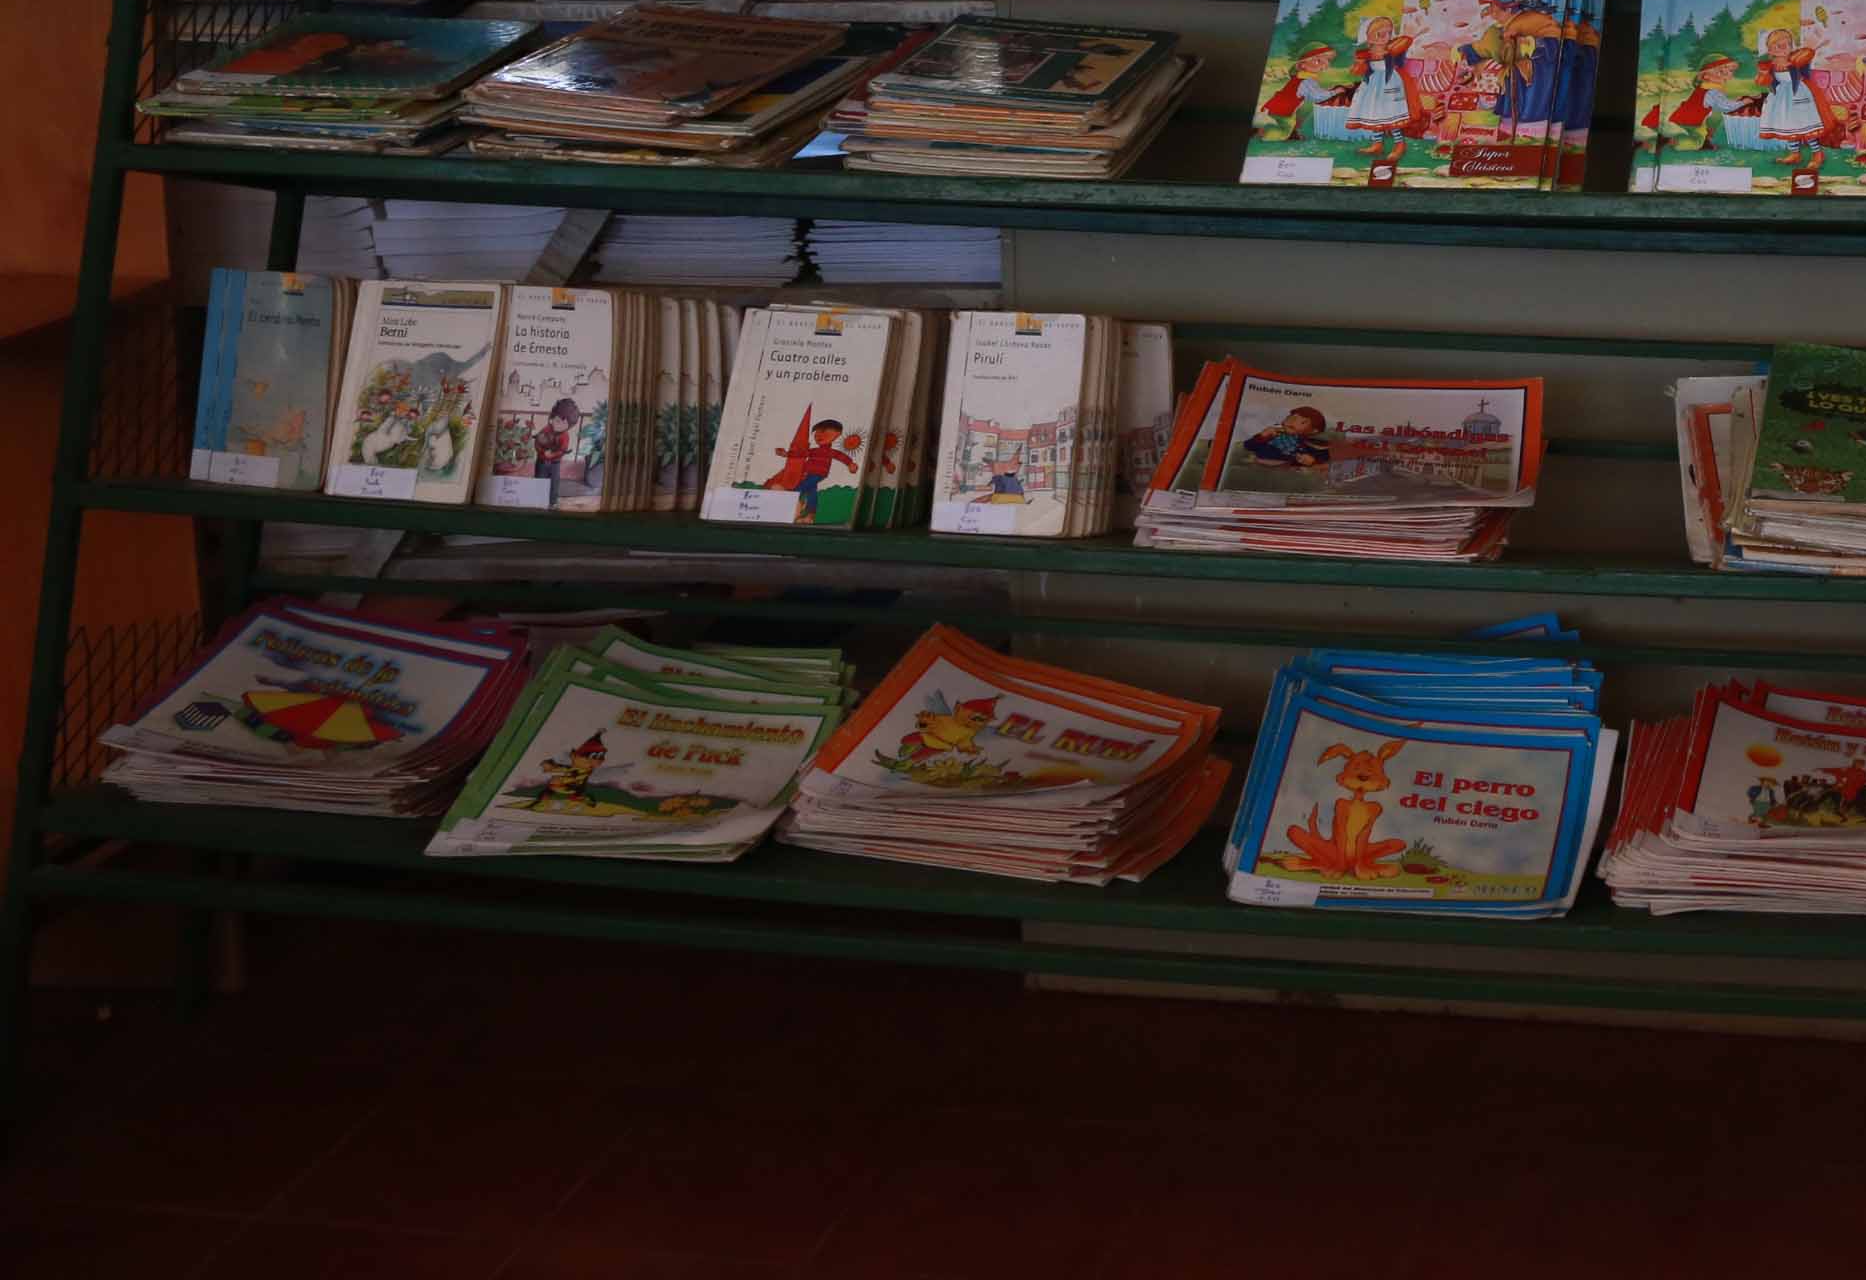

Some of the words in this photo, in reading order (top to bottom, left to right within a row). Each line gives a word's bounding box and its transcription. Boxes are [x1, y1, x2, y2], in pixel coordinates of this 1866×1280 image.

[379, 326, 409, 338] Berni
[515, 324, 528, 337] La
[530, 325, 571, 340] historia
[513, 341, 527, 354] de
[528, 342, 569, 356] Ernesto
[769, 349, 810, 365] Cuatro
[812, 353, 848, 367] calles
[765, 368, 773, 382] y
[775, 371, 791, 380] un
[792, 369, 850, 384] problema
[1807, 398, 1836, 410] LO
[1335, 421, 1376, 434] Las
[996, 712, 1046, 746] EL
[646, 740, 680, 760] de
[1413, 769, 1444, 788] El
[1451, 778, 1536, 799] perro
[1399, 793, 1448, 813] del
[1455, 800, 1540, 823] ciego
[1432, 815, 1467, 827] Rubén
